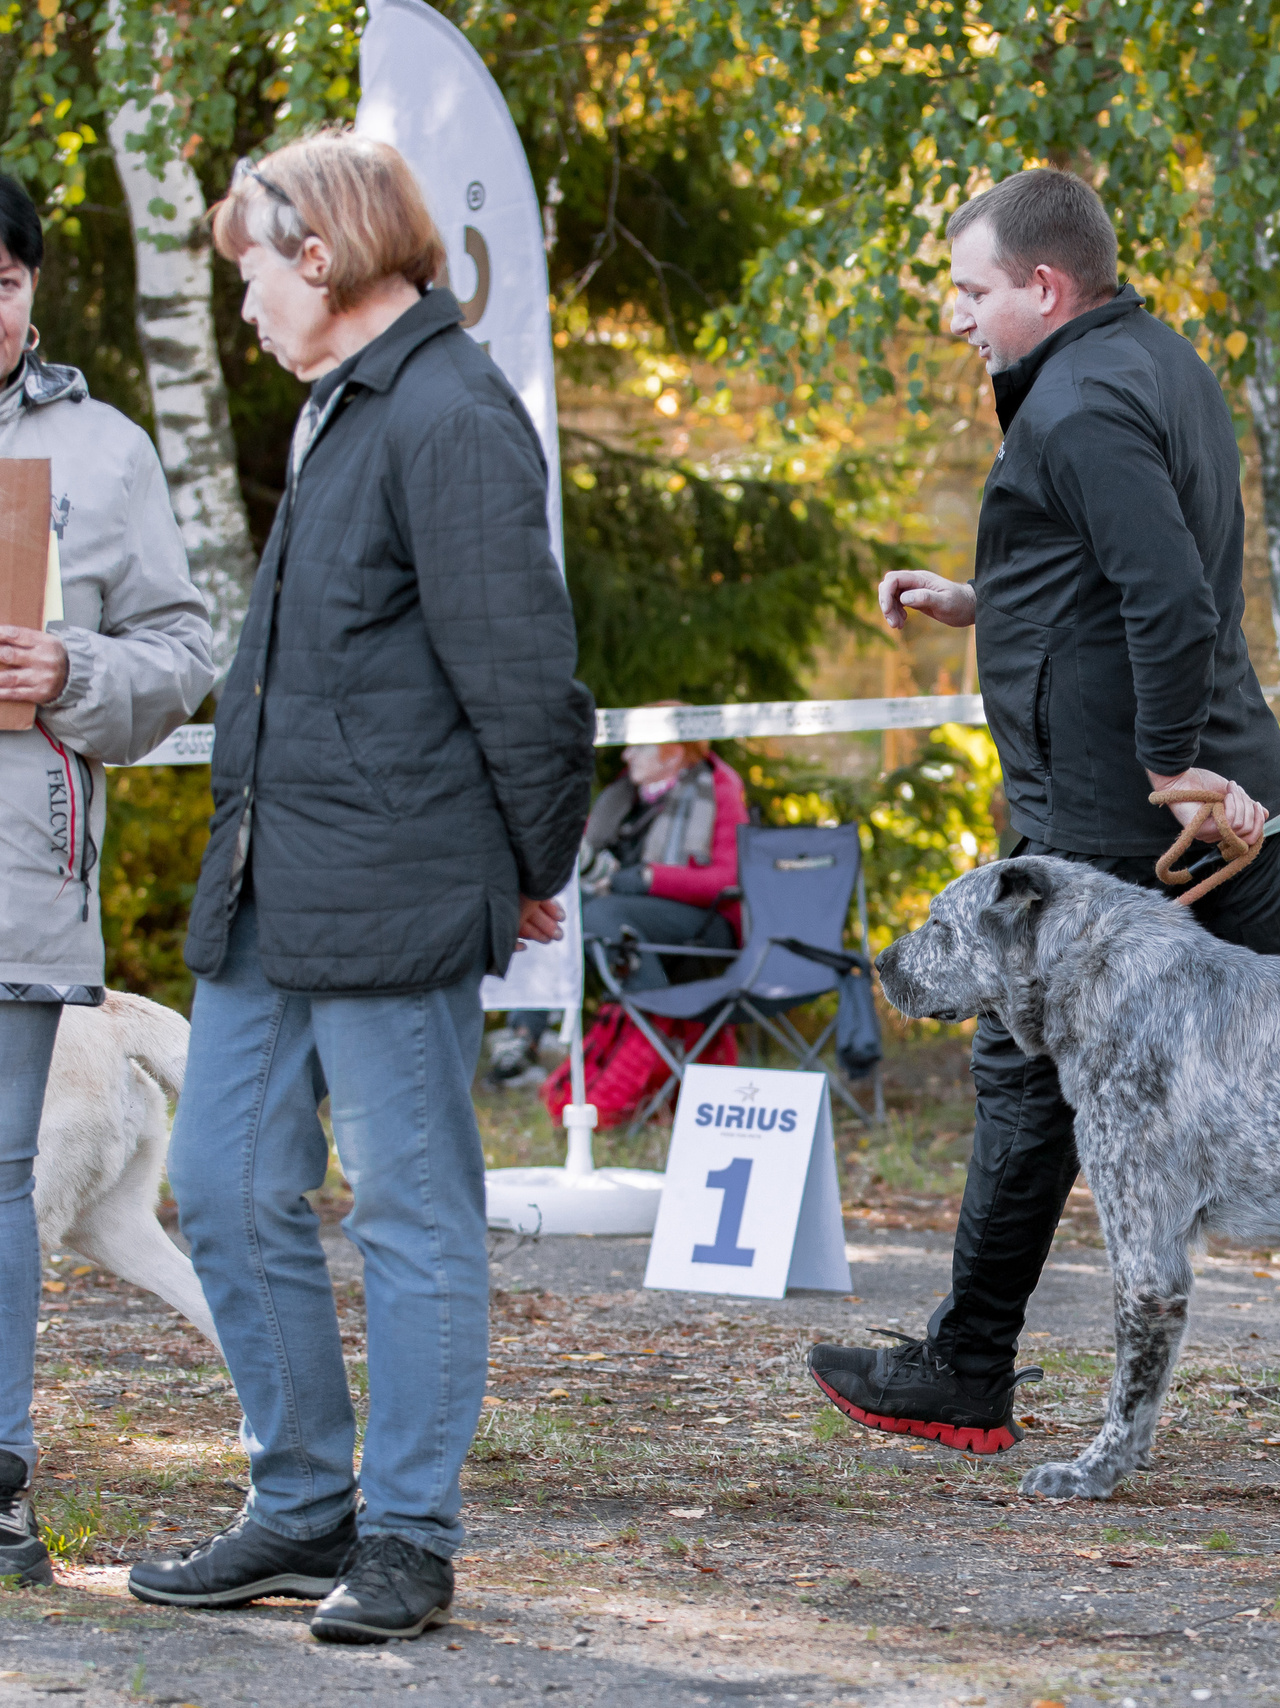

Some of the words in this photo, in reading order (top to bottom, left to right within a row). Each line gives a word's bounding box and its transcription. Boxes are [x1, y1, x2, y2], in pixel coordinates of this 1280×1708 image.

[47, 769, 68, 854] FKLCVY
[695, 1103, 798, 1132] SIRIUS
[692, 1157, 755, 1267] 1
